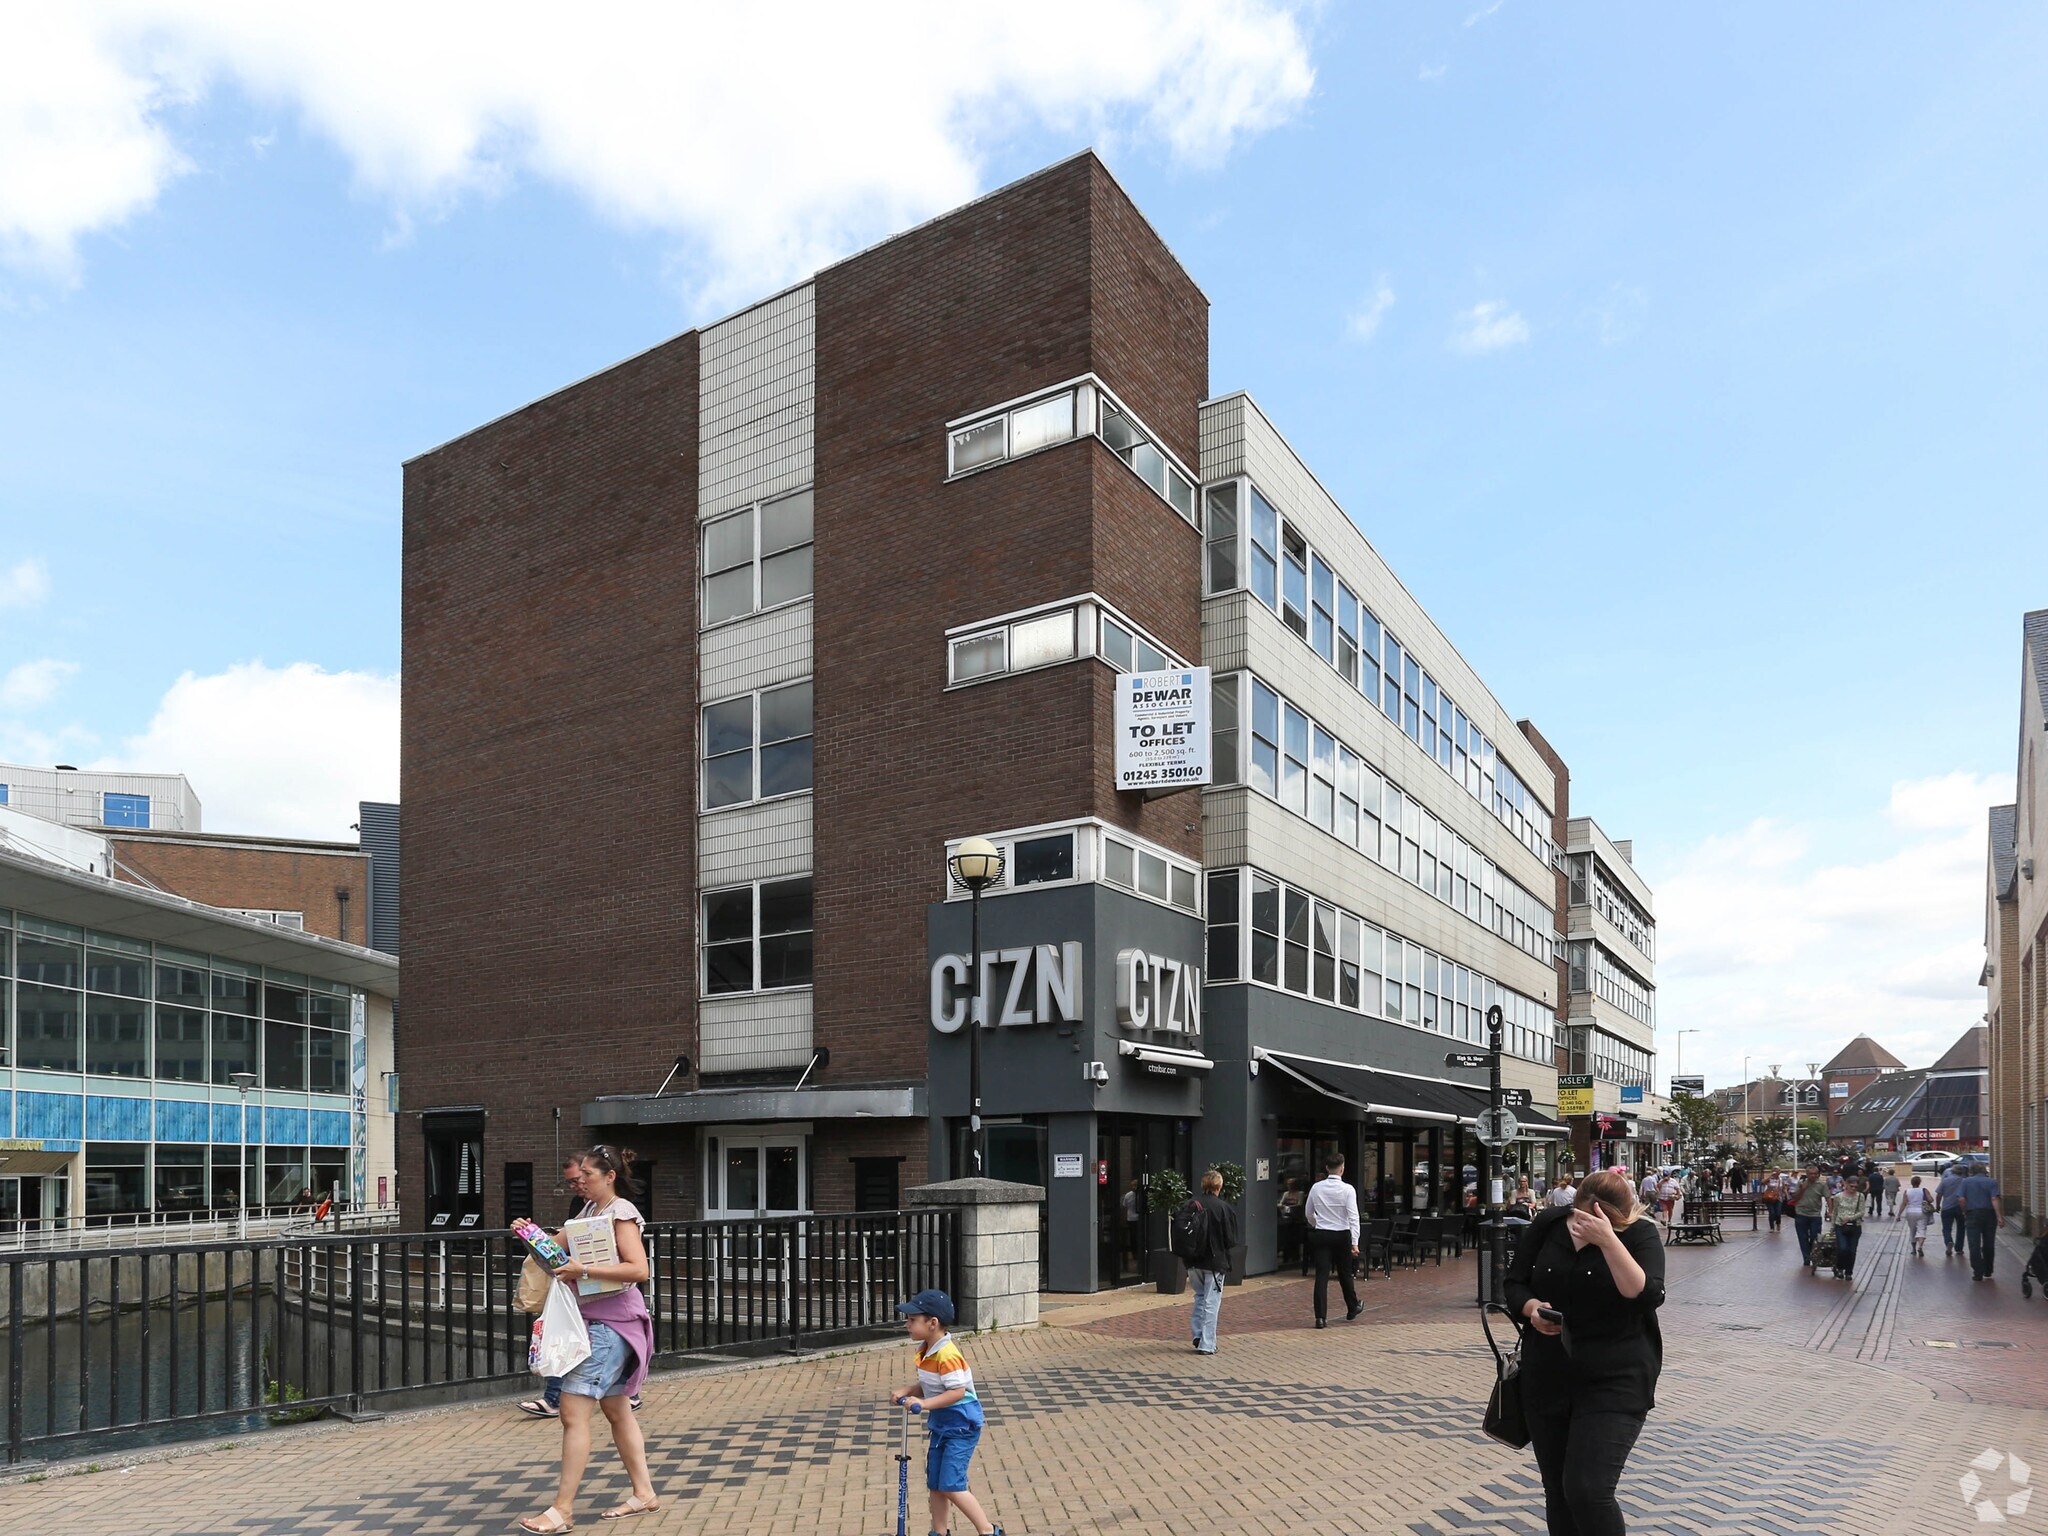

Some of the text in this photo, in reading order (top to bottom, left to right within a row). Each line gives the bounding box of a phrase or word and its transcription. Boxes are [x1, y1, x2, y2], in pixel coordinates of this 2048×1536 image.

[1143, 675, 1180, 688] ROBERT
[1132, 688, 1192, 703] DEWAR
[1132, 700, 1193, 709] ASSOCIATES
[1129, 722, 1196, 738] TO LET
[1139, 737, 1185, 747] OFFICES
[1145, 749, 1152, 757] to
[1154, 748, 1175, 757] 2,500
[1123, 766, 1203, 781] 01245 350160
[931, 941, 1083, 1033] CTZN
[1118, 948, 1200, 1035] CTZN
[1148, 1064, 1177, 1075] ctznbar.com
